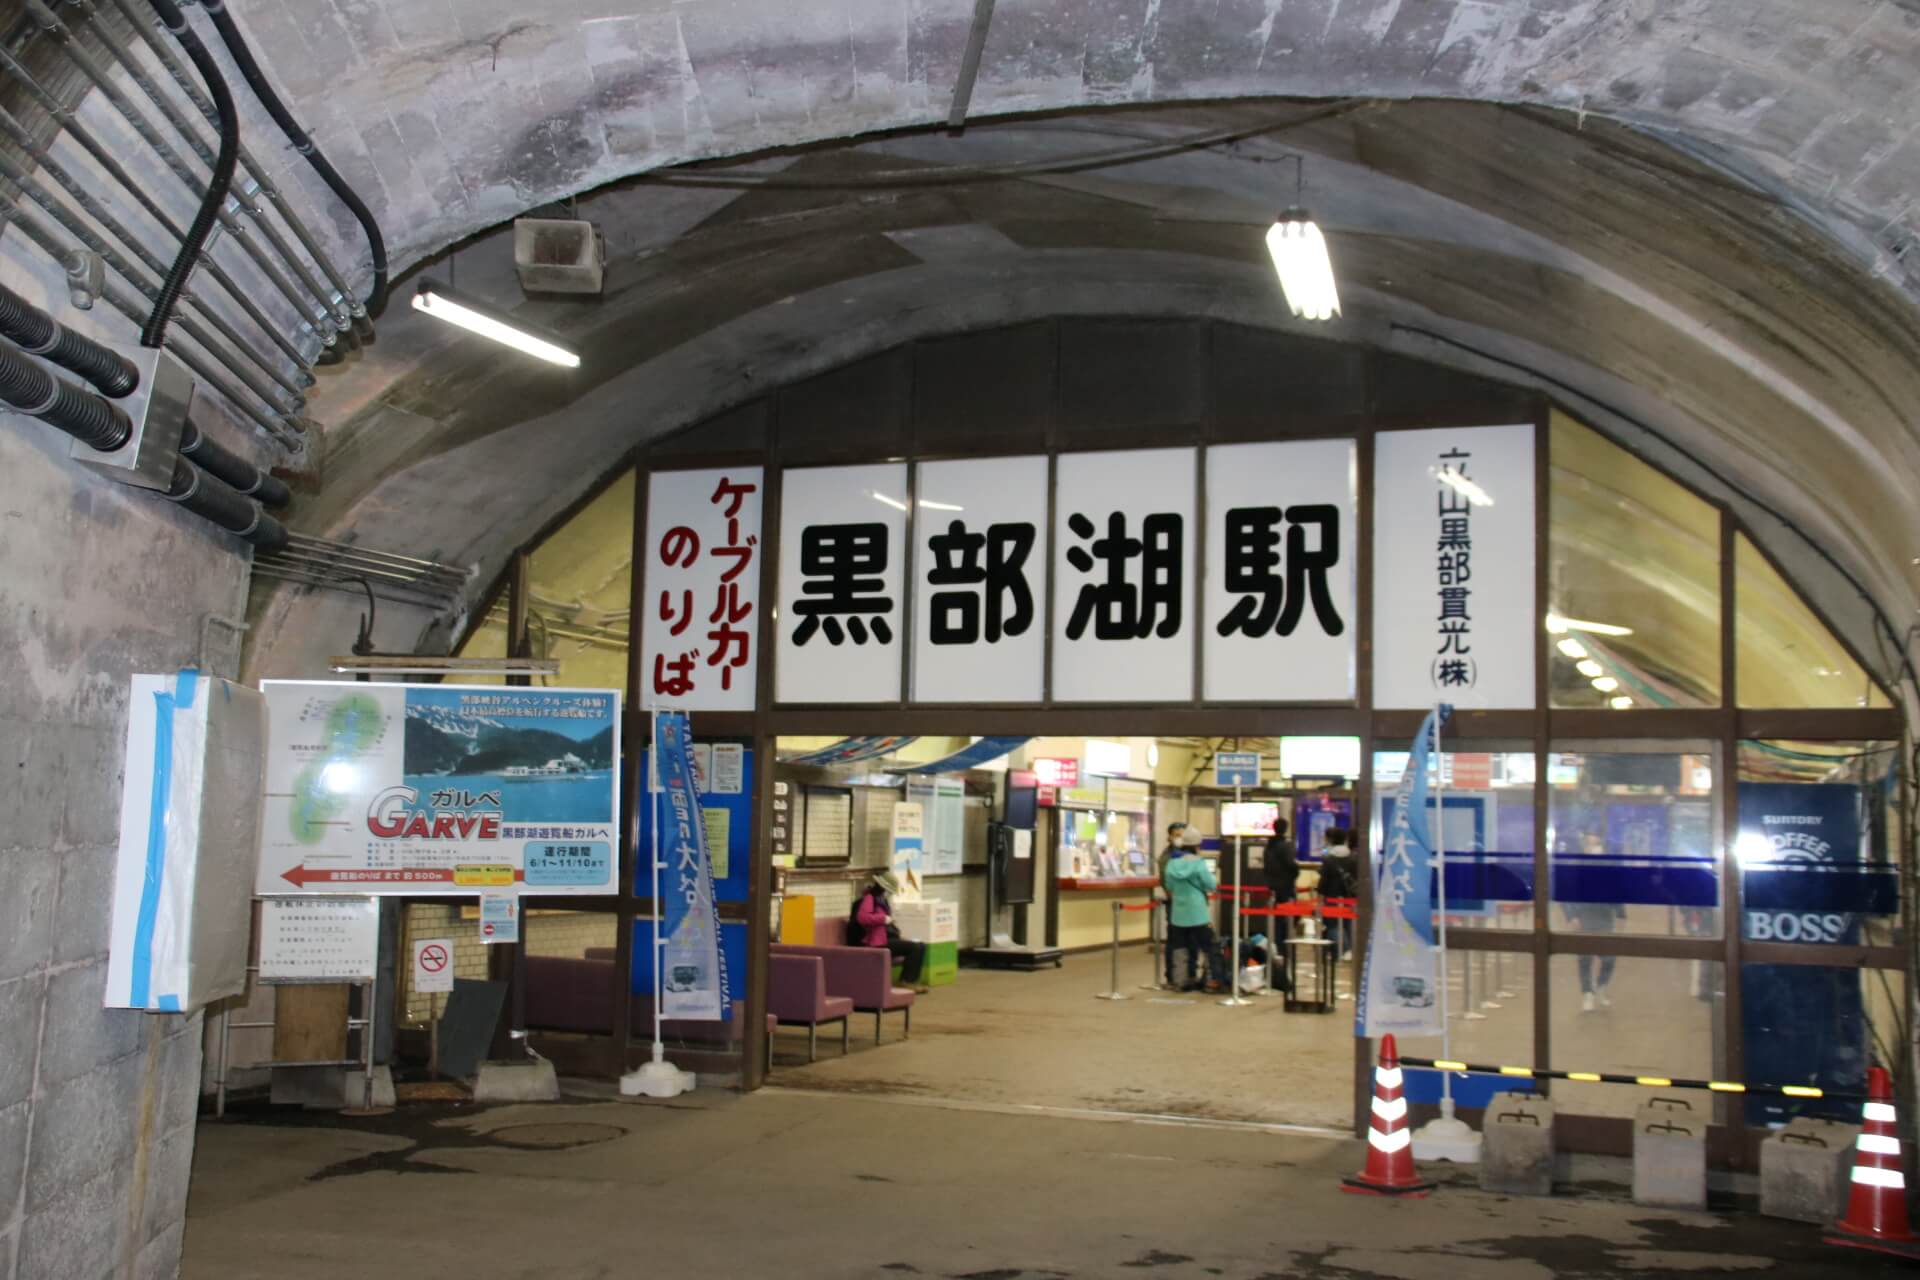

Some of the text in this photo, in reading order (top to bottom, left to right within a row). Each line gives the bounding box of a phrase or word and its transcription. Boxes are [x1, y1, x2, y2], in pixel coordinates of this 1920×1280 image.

[707, 477, 757, 690] ケーブルカー
[792, 503, 1345, 647] 黒部湖駅
[653, 526, 701, 696] のりば
[367, 785, 502, 841] GARVE
[431, 789, 500, 807] ガルベ
[1762, 814, 1824, 825] SUNTORY
[544, 846, 592, 857] 運行期間
[1766, 831, 1832, 858] OFFEE
[1748, 911, 1844, 943] BOSS
